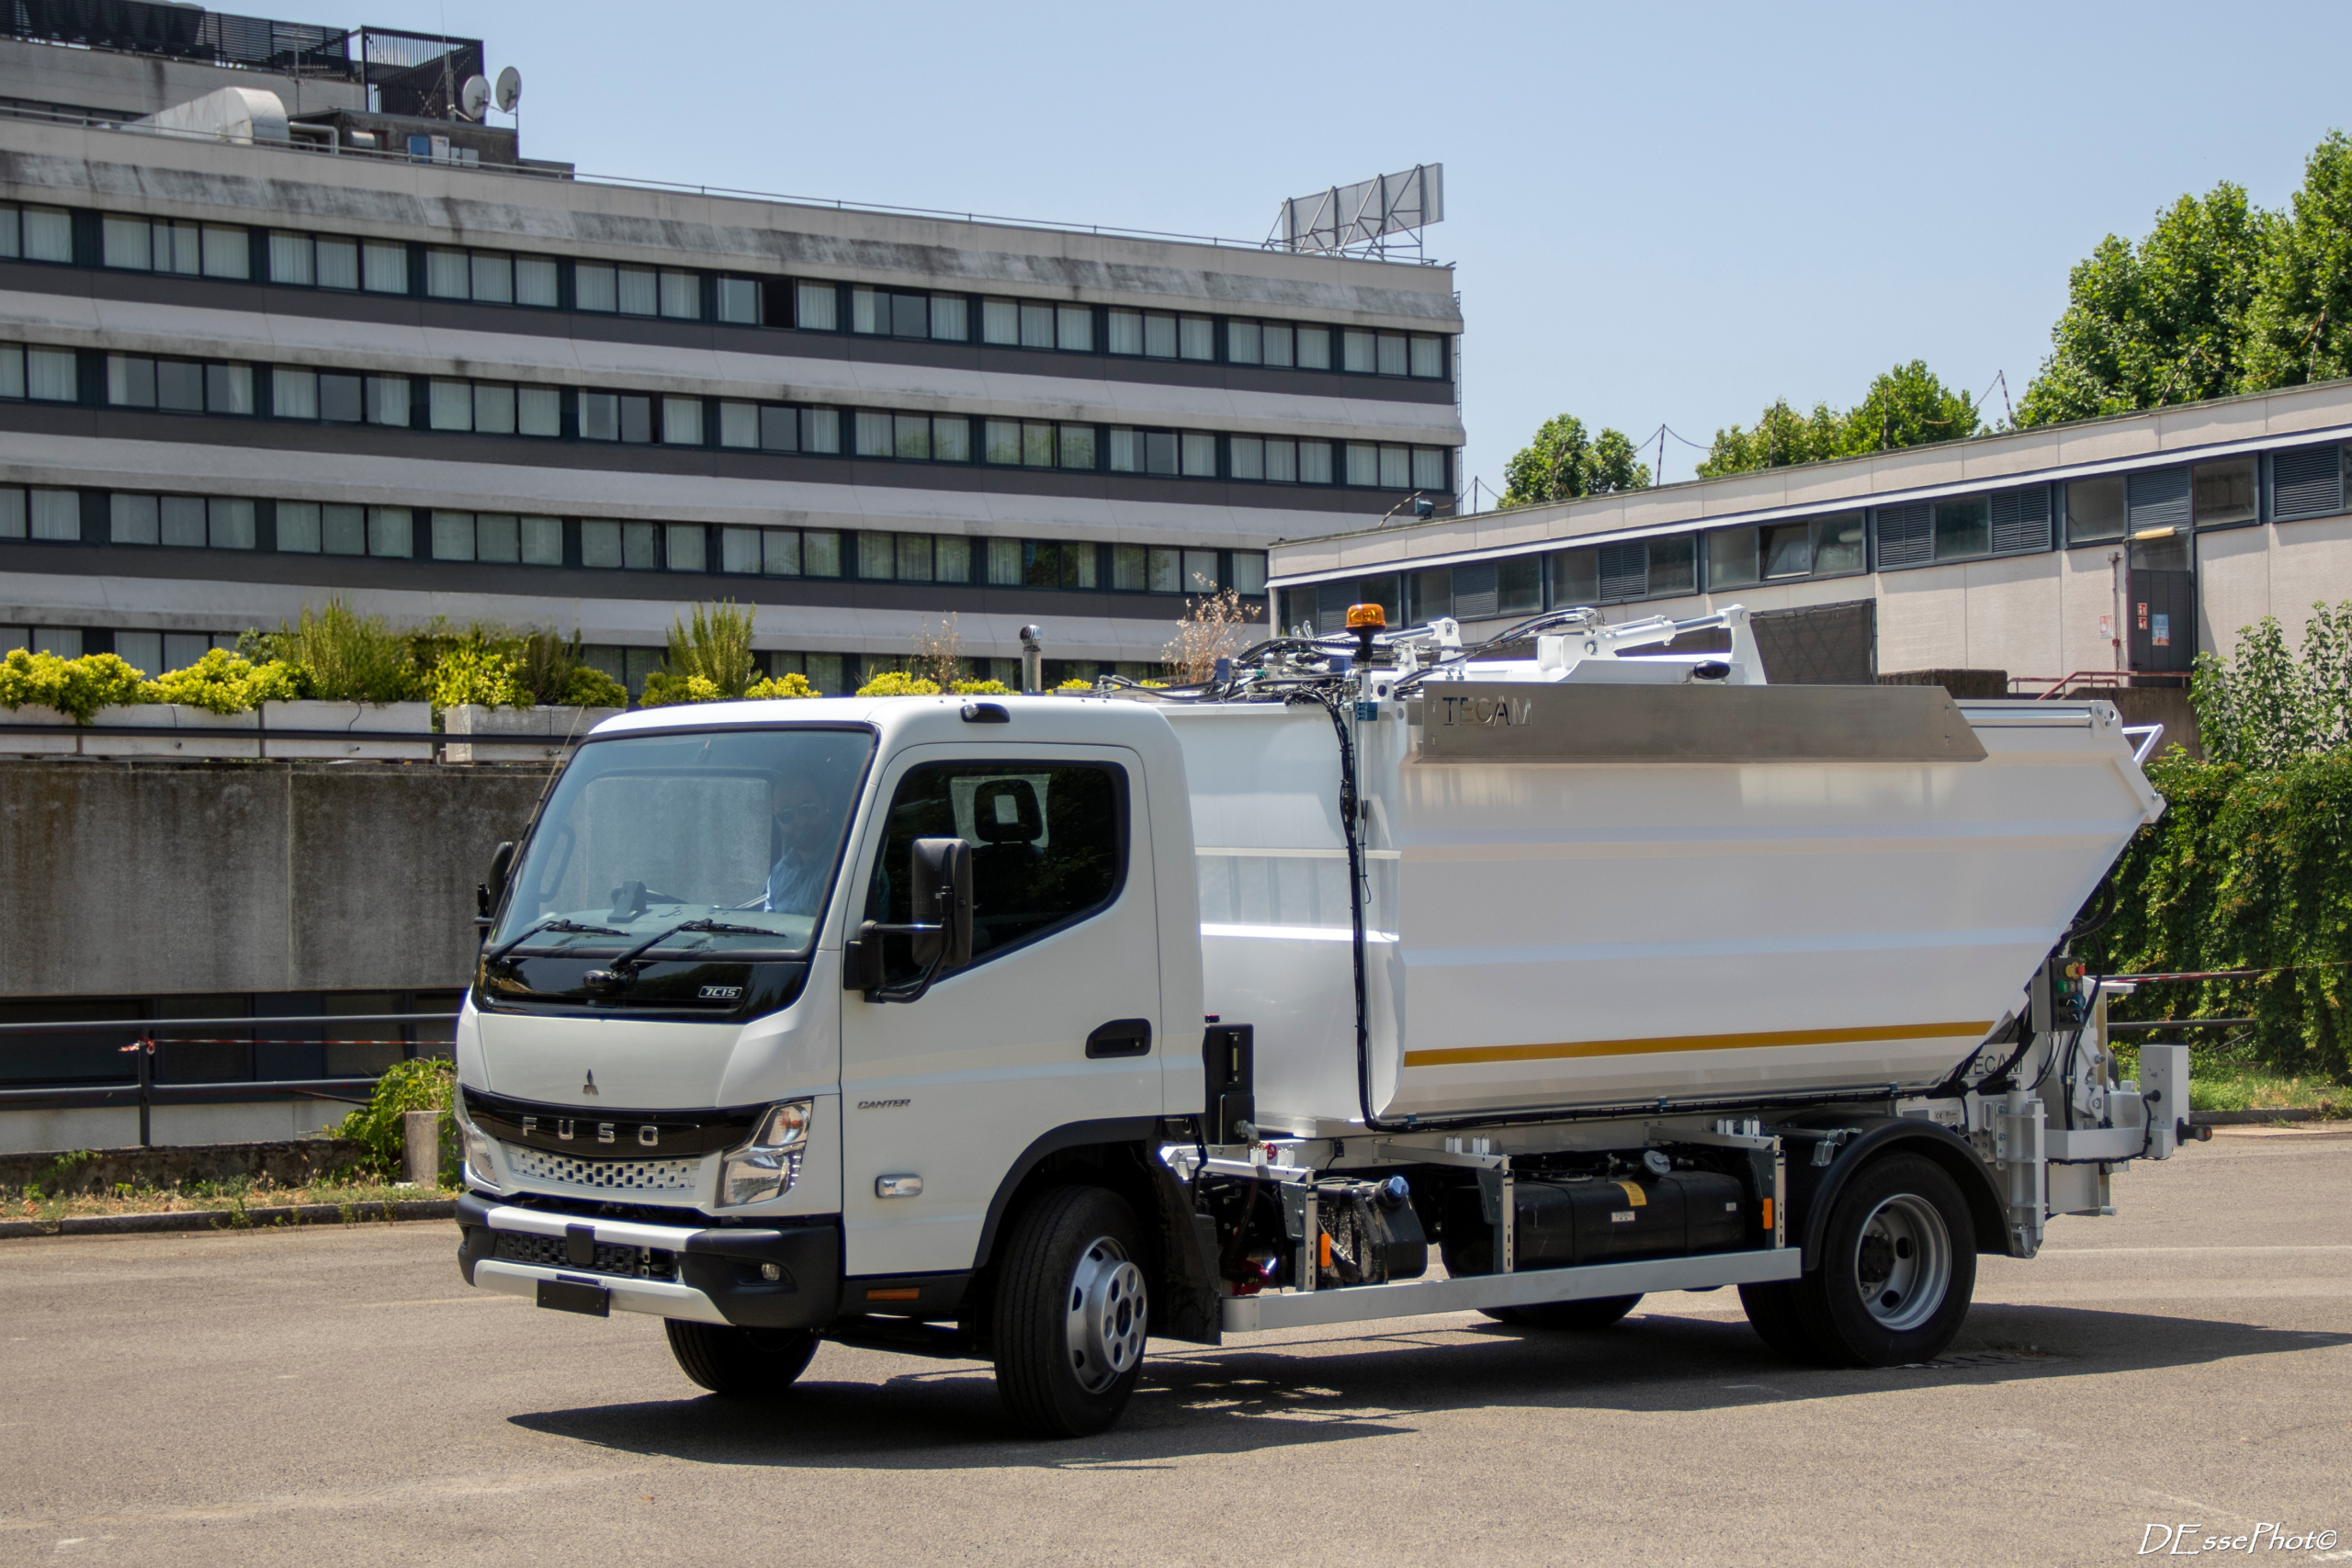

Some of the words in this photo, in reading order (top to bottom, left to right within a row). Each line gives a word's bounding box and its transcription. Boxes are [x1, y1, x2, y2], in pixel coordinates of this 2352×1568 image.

[1442, 695, 1532, 726] TECAM
[706, 988, 737, 997] 7C15
[857, 1099, 910, 1110] CANTER
[523, 1116, 659, 1146] FUSO
